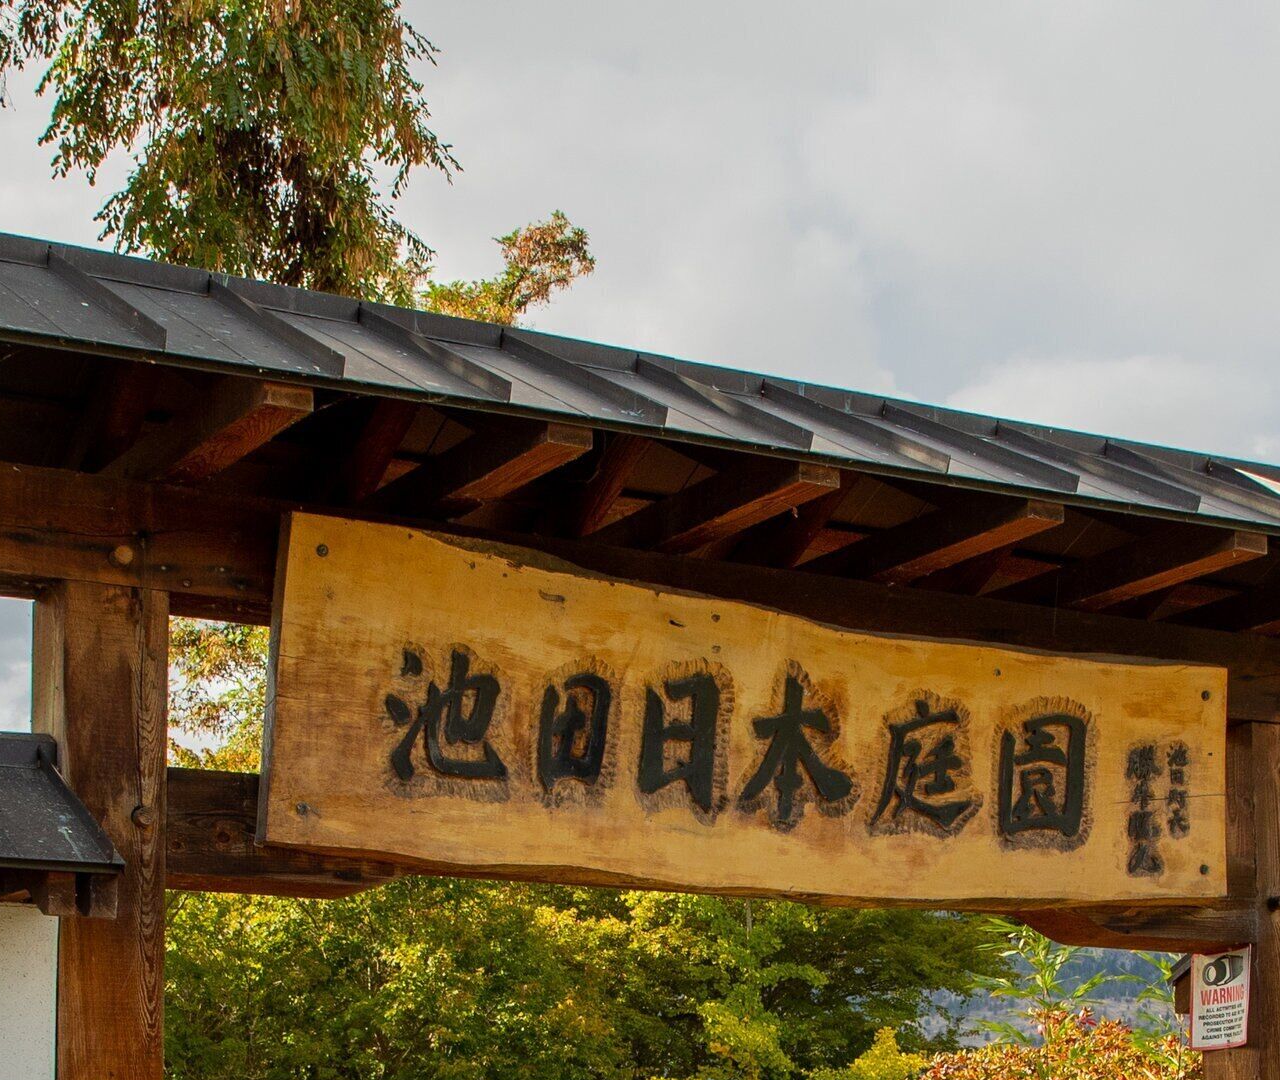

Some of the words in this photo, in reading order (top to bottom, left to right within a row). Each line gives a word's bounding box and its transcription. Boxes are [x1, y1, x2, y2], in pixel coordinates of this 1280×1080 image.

[384, 645, 1087, 838] 池田日本庭園
[1201, 984, 1244, 1006] WARNING
[1203, 1019, 1233, 1027] PROSECUTION
